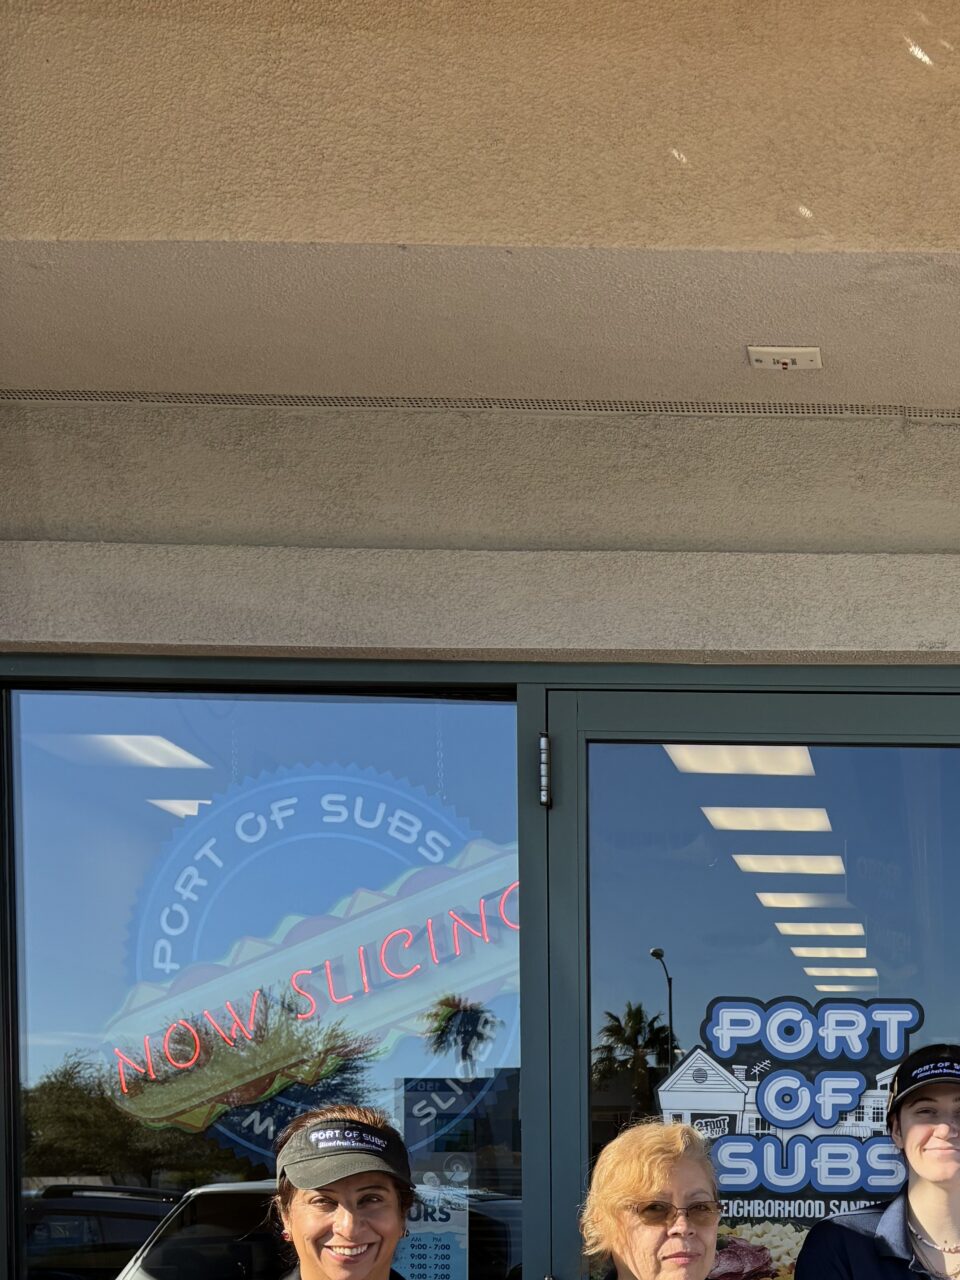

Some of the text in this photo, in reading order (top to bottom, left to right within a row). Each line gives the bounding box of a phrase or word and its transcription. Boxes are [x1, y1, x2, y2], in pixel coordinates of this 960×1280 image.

[153, 793, 452, 974] PORT OF SUBS
[114, 990, 261, 1095] NOW
[713, 1008, 914, 1055] PORT
[763, 1070, 861, 1121] OF
[310, 1129, 386, 1148] PORT OF SUBS
[717, 1141, 907, 1187] SUBS
[720, 1199, 827, 1218] EIGHBORHOOD
